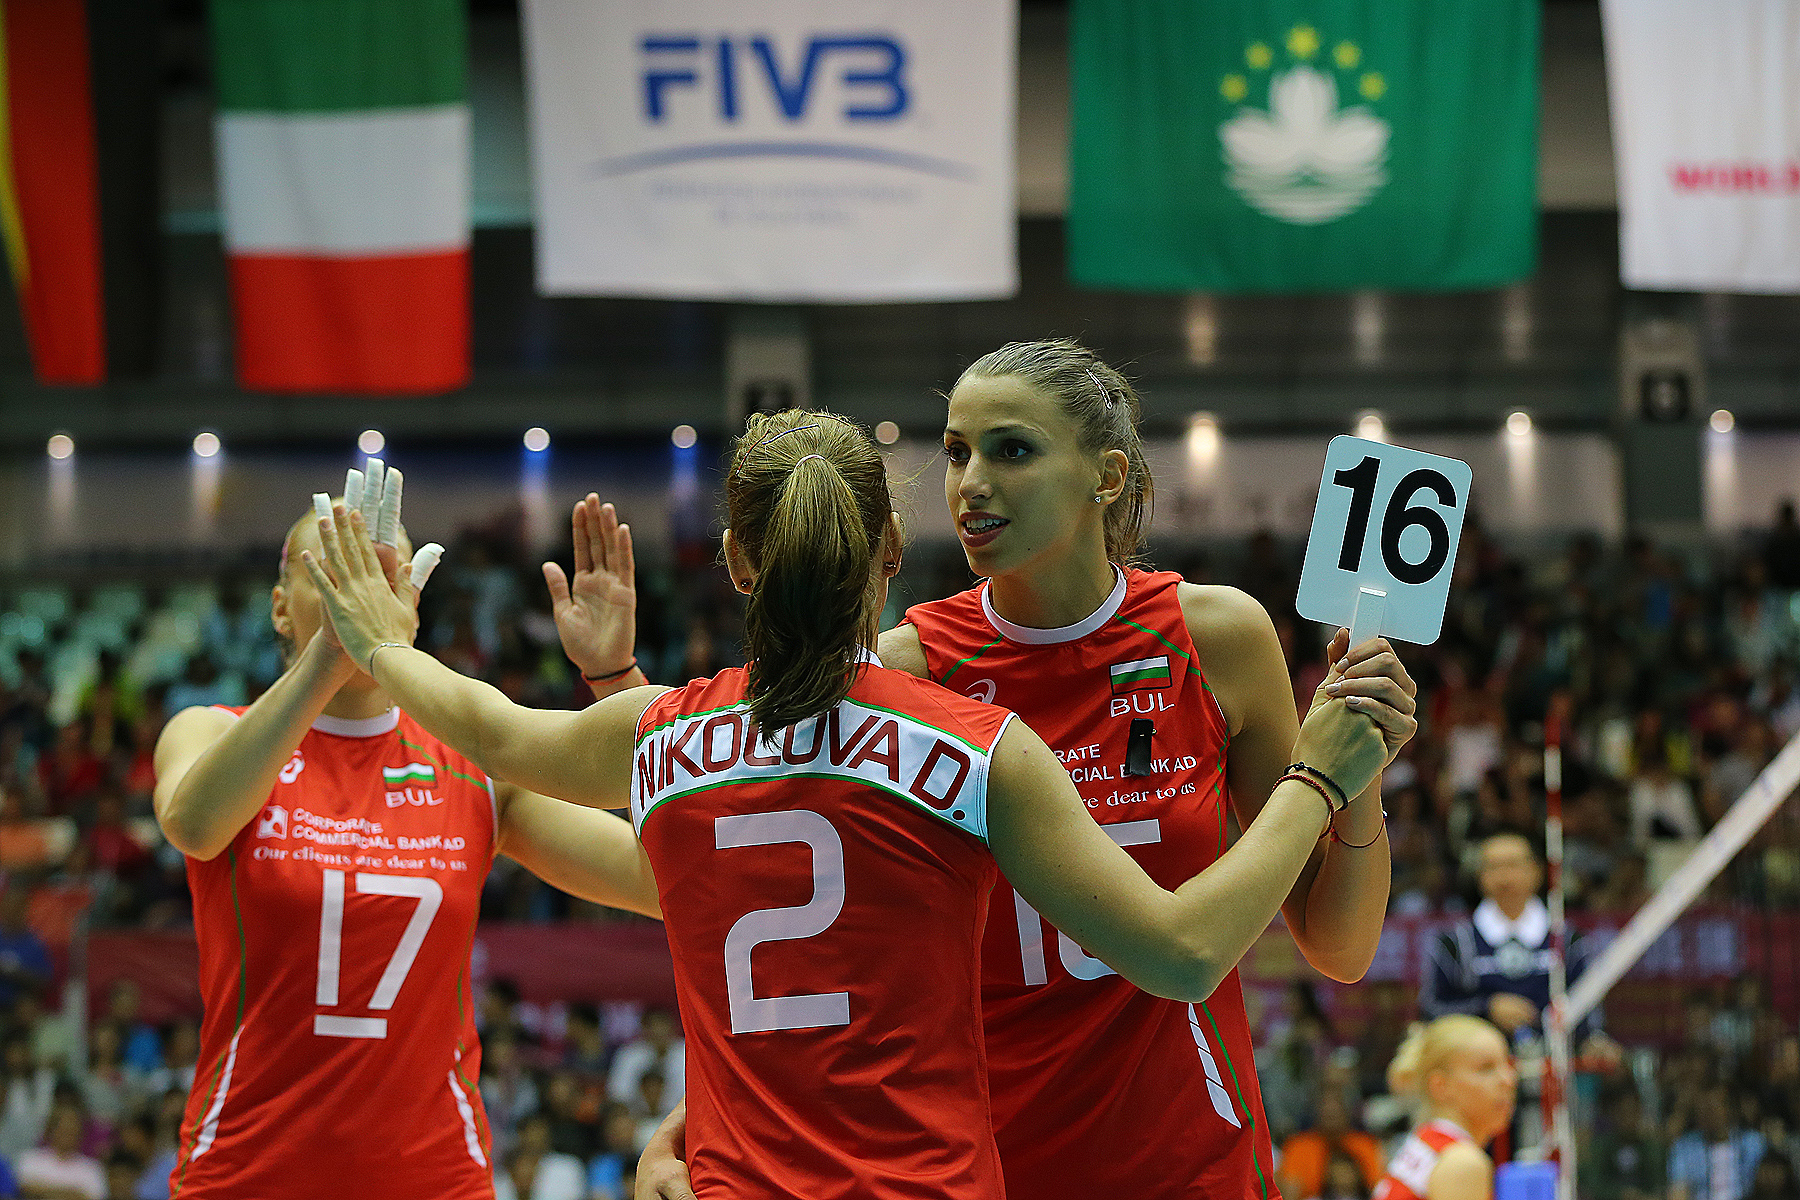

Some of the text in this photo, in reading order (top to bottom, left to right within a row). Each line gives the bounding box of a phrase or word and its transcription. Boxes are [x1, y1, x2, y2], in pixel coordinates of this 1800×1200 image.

[638, 35, 914, 121] FIVB
[1333, 455, 1457, 585] 16
[1110, 692, 1175, 718] BUL
[385, 788, 444, 808] BUL
[637, 706, 900, 812] NIKOLOVA
[1106, 790, 1150, 807] dear
[1155, 786, 1177, 800] to
[1180, 782, 1196, 796] us
[253, 846, 468, 872] Our clients are dear to us
[316, 869, 443, 1010] 17
[715, 809, 850, 1034] 2
